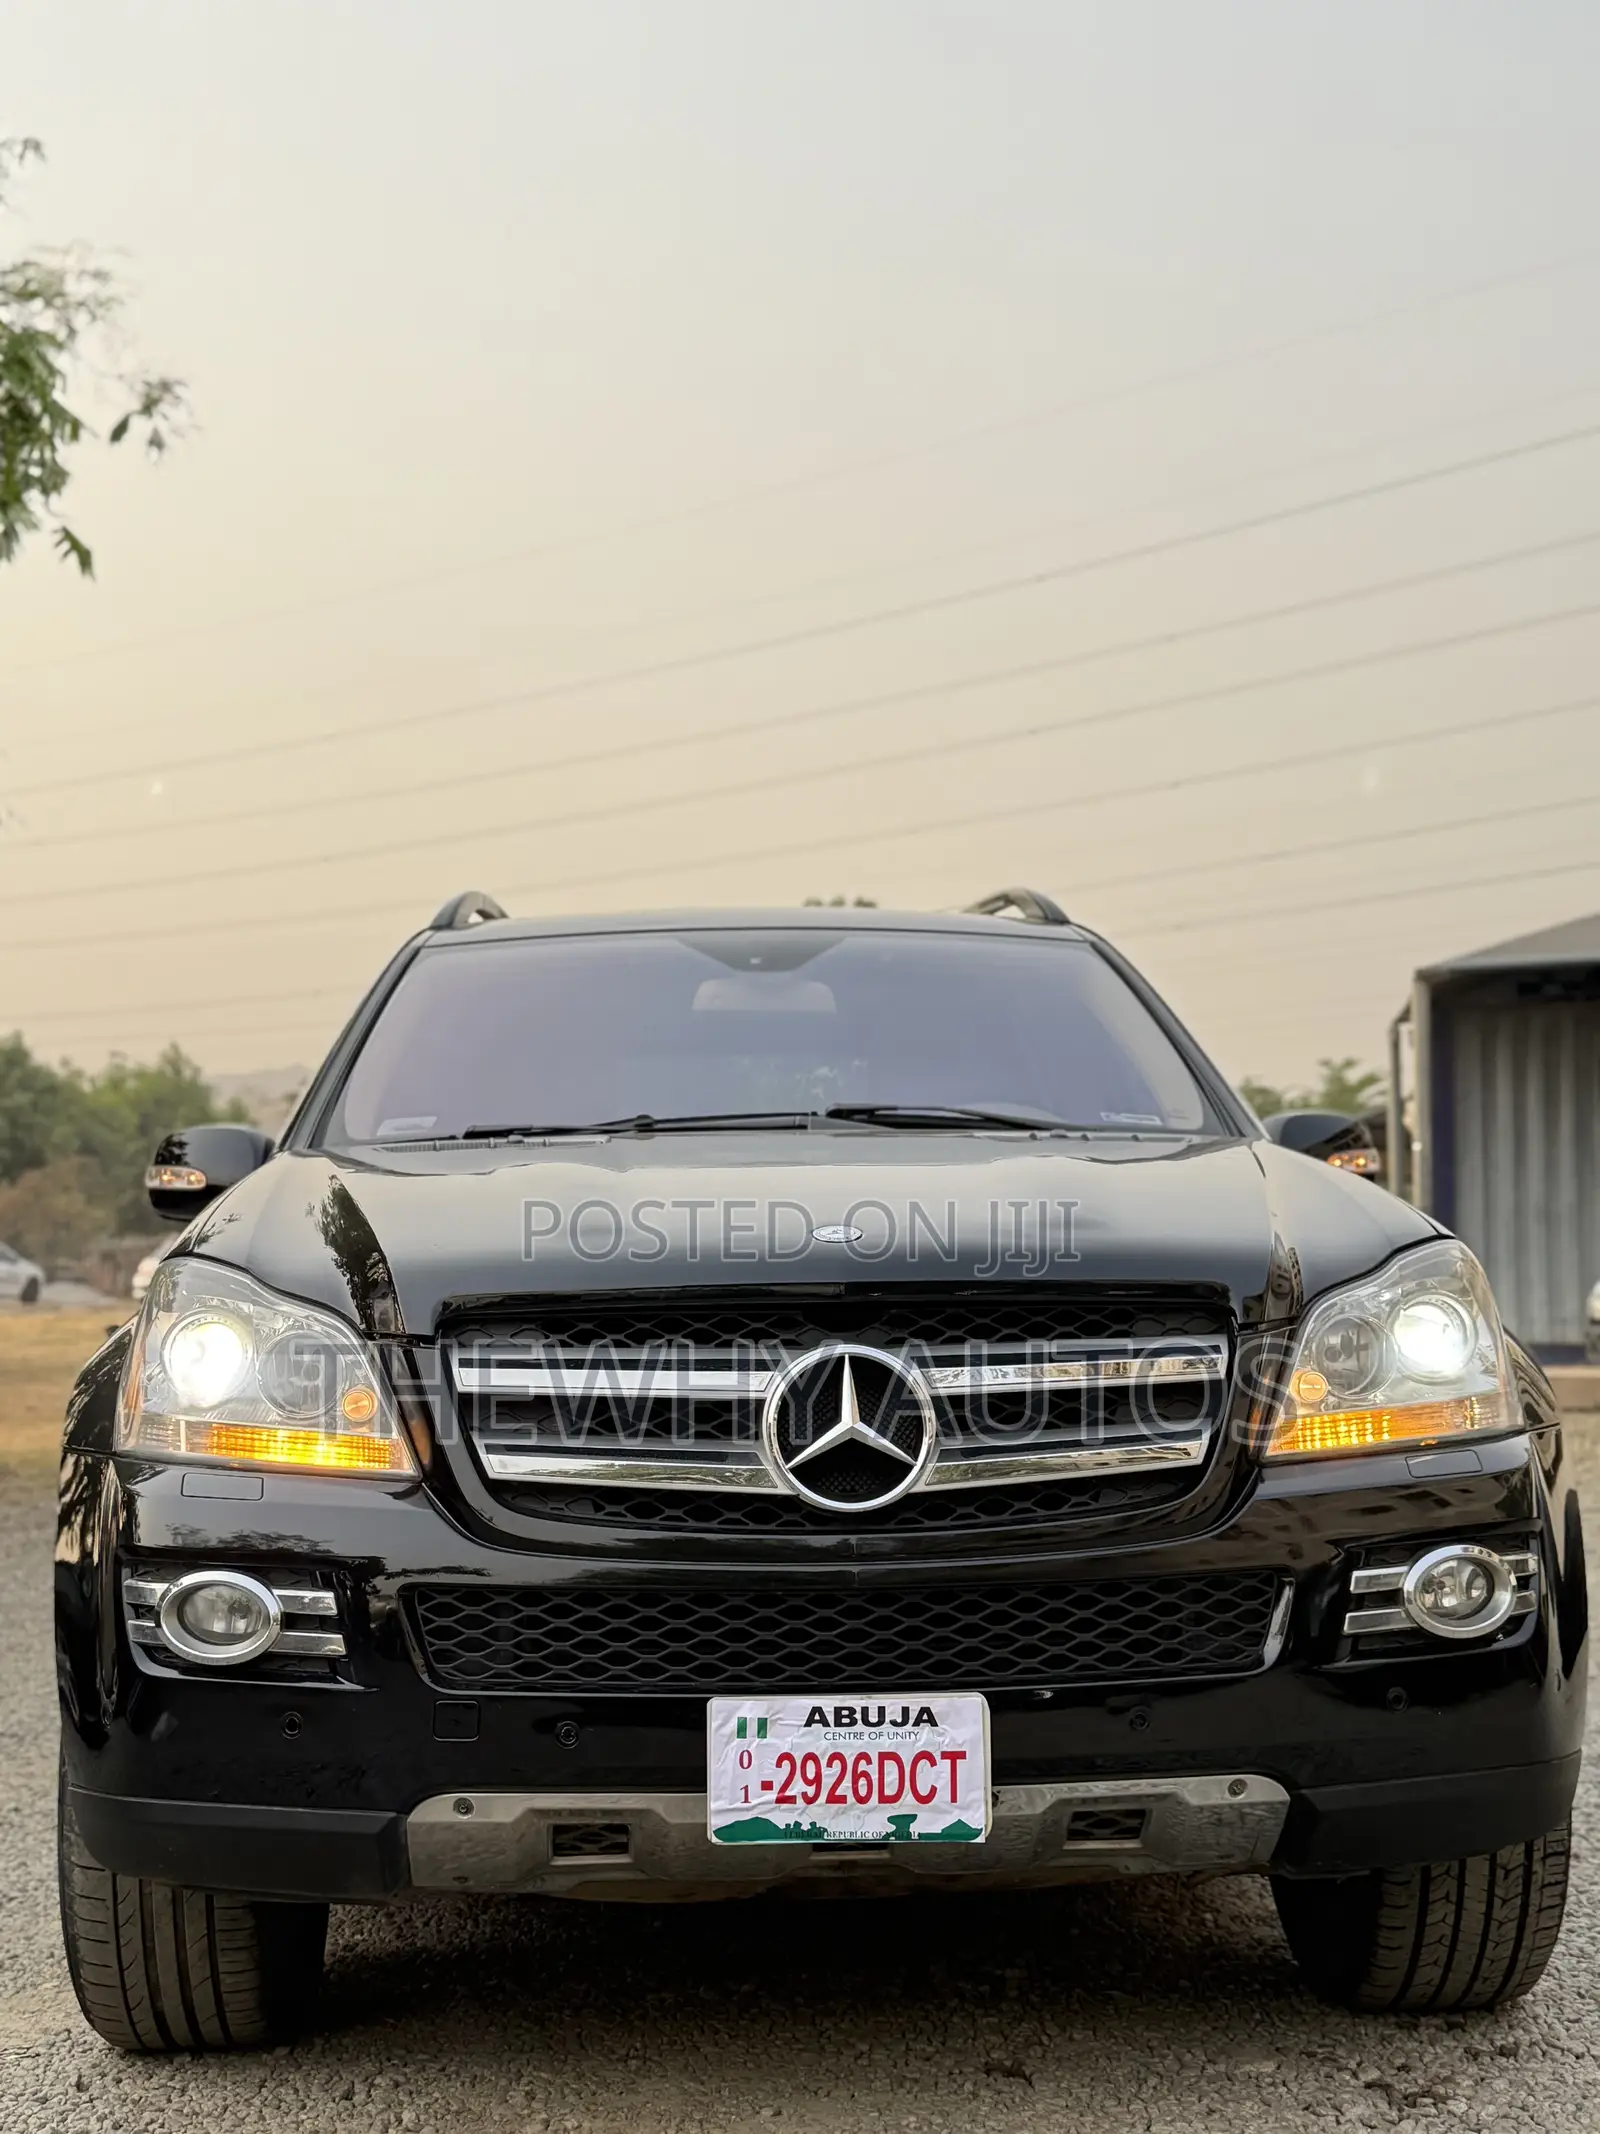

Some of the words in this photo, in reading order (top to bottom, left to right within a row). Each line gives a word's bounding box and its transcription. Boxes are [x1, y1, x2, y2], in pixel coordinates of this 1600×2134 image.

[803, 1705, 938, 1728] ABUJA
[824, 1731, 865, 1741] CENTRE
[868, 1731, 884, 1741] OF
[887, 1731, 919, 1741] UNITY
[826, 1830, 869, 1839] REPUBLIC
[871, 1830, 883, 1839] OF
